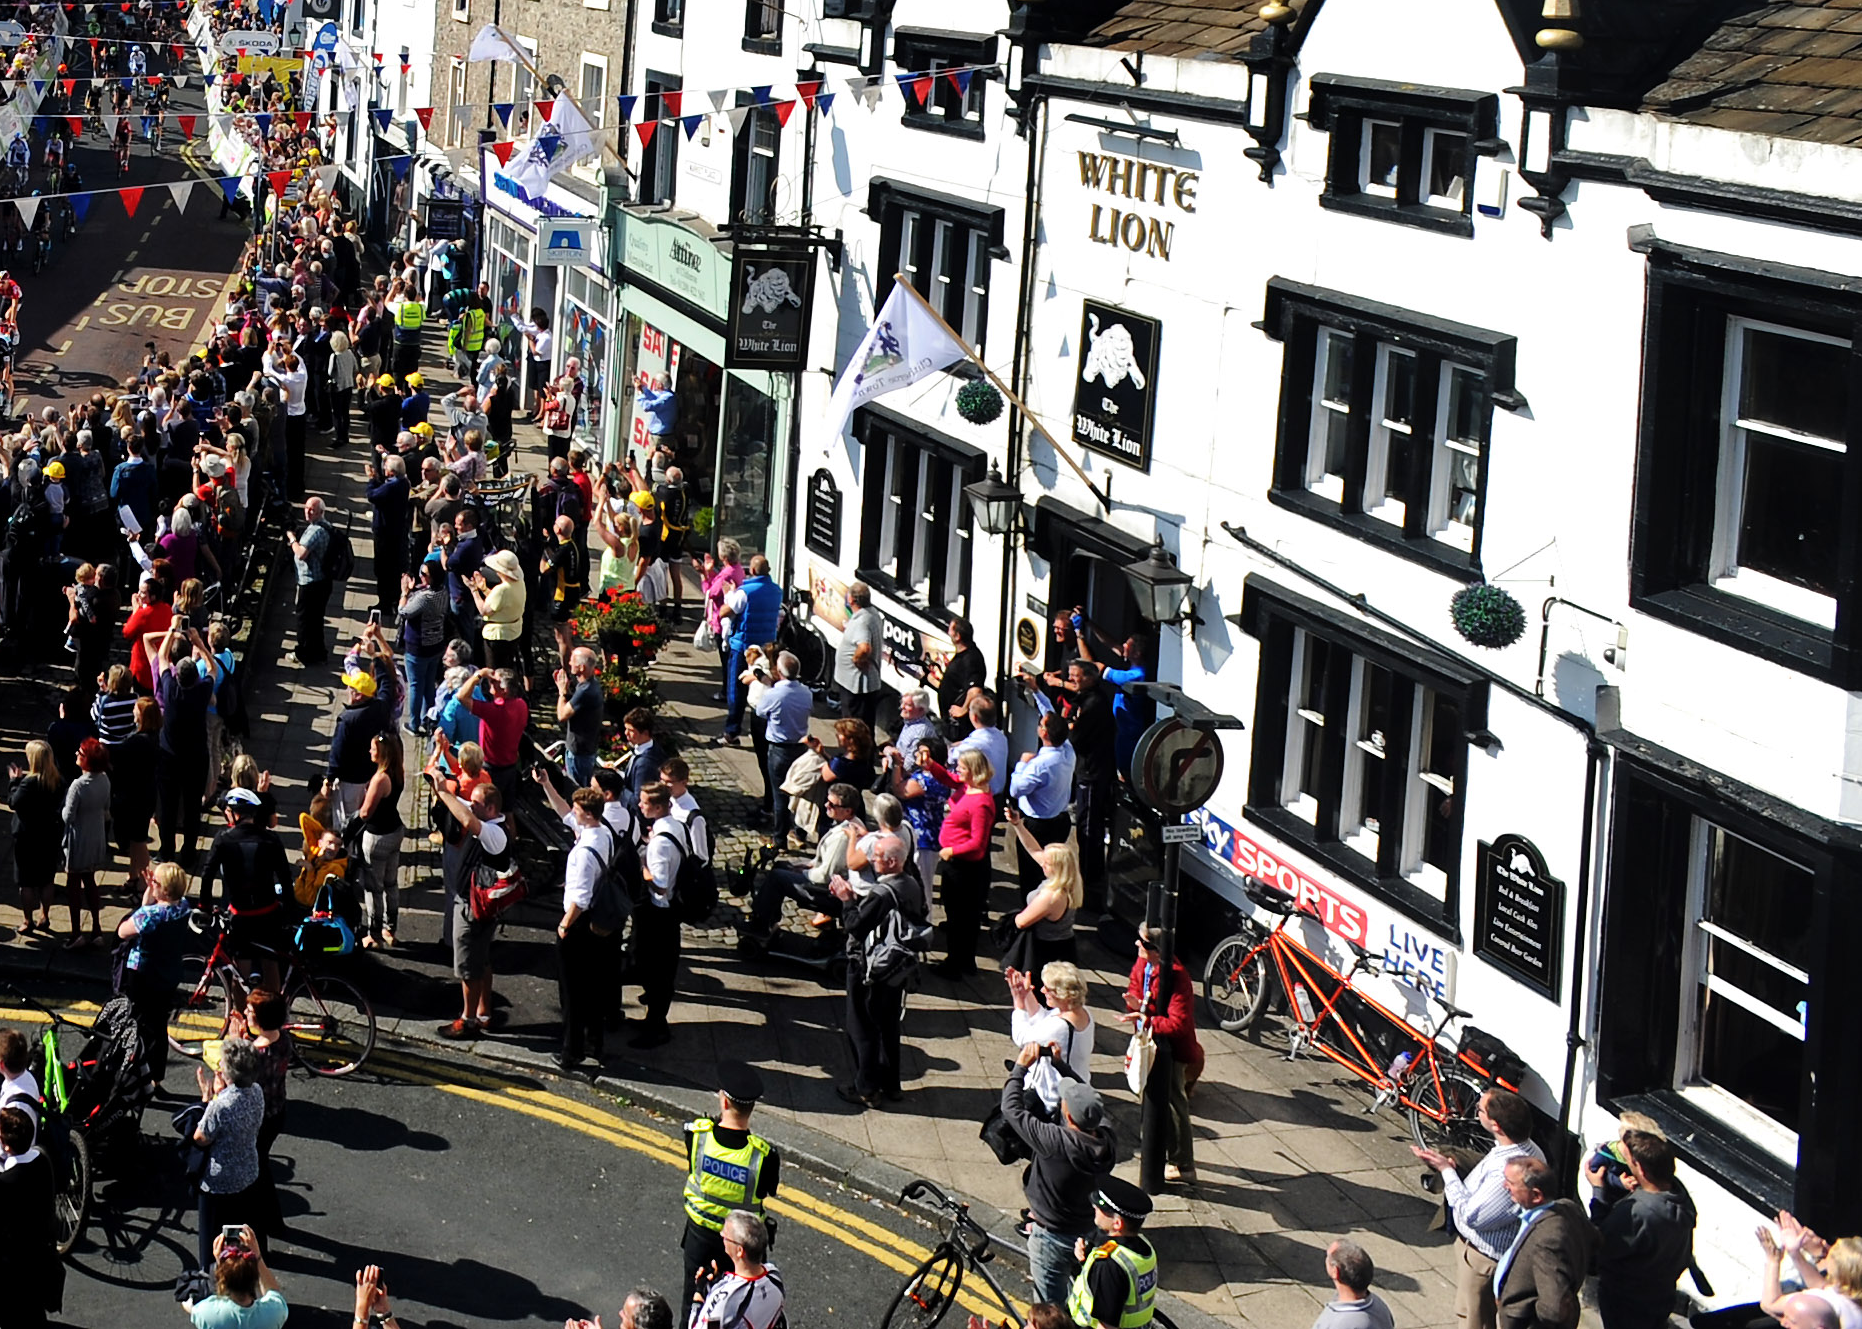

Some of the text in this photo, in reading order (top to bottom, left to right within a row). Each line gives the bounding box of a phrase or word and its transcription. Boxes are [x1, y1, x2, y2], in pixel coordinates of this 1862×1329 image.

[1078, 151, 1200, 214] WHITE
[1088, 203, 1175, 261] LION
[118, 275, 223, 299] STOP
[99, 303, 196, 331] BUS
[761, 319, 779, 331] The
[738, 337, 798, 353] White Lion
[1101, 396, 1120, 415] The
[1076, 413, 1142, 457] White Lion
[881, 617, 915, 651] port
[1236, 838, 1364, 941] SPORTS
[1389, 924, 1445, 975] LIVE
[1383, 949, 1446, 1000] HERE
[702, 1157, 749, 1183] POLICE
